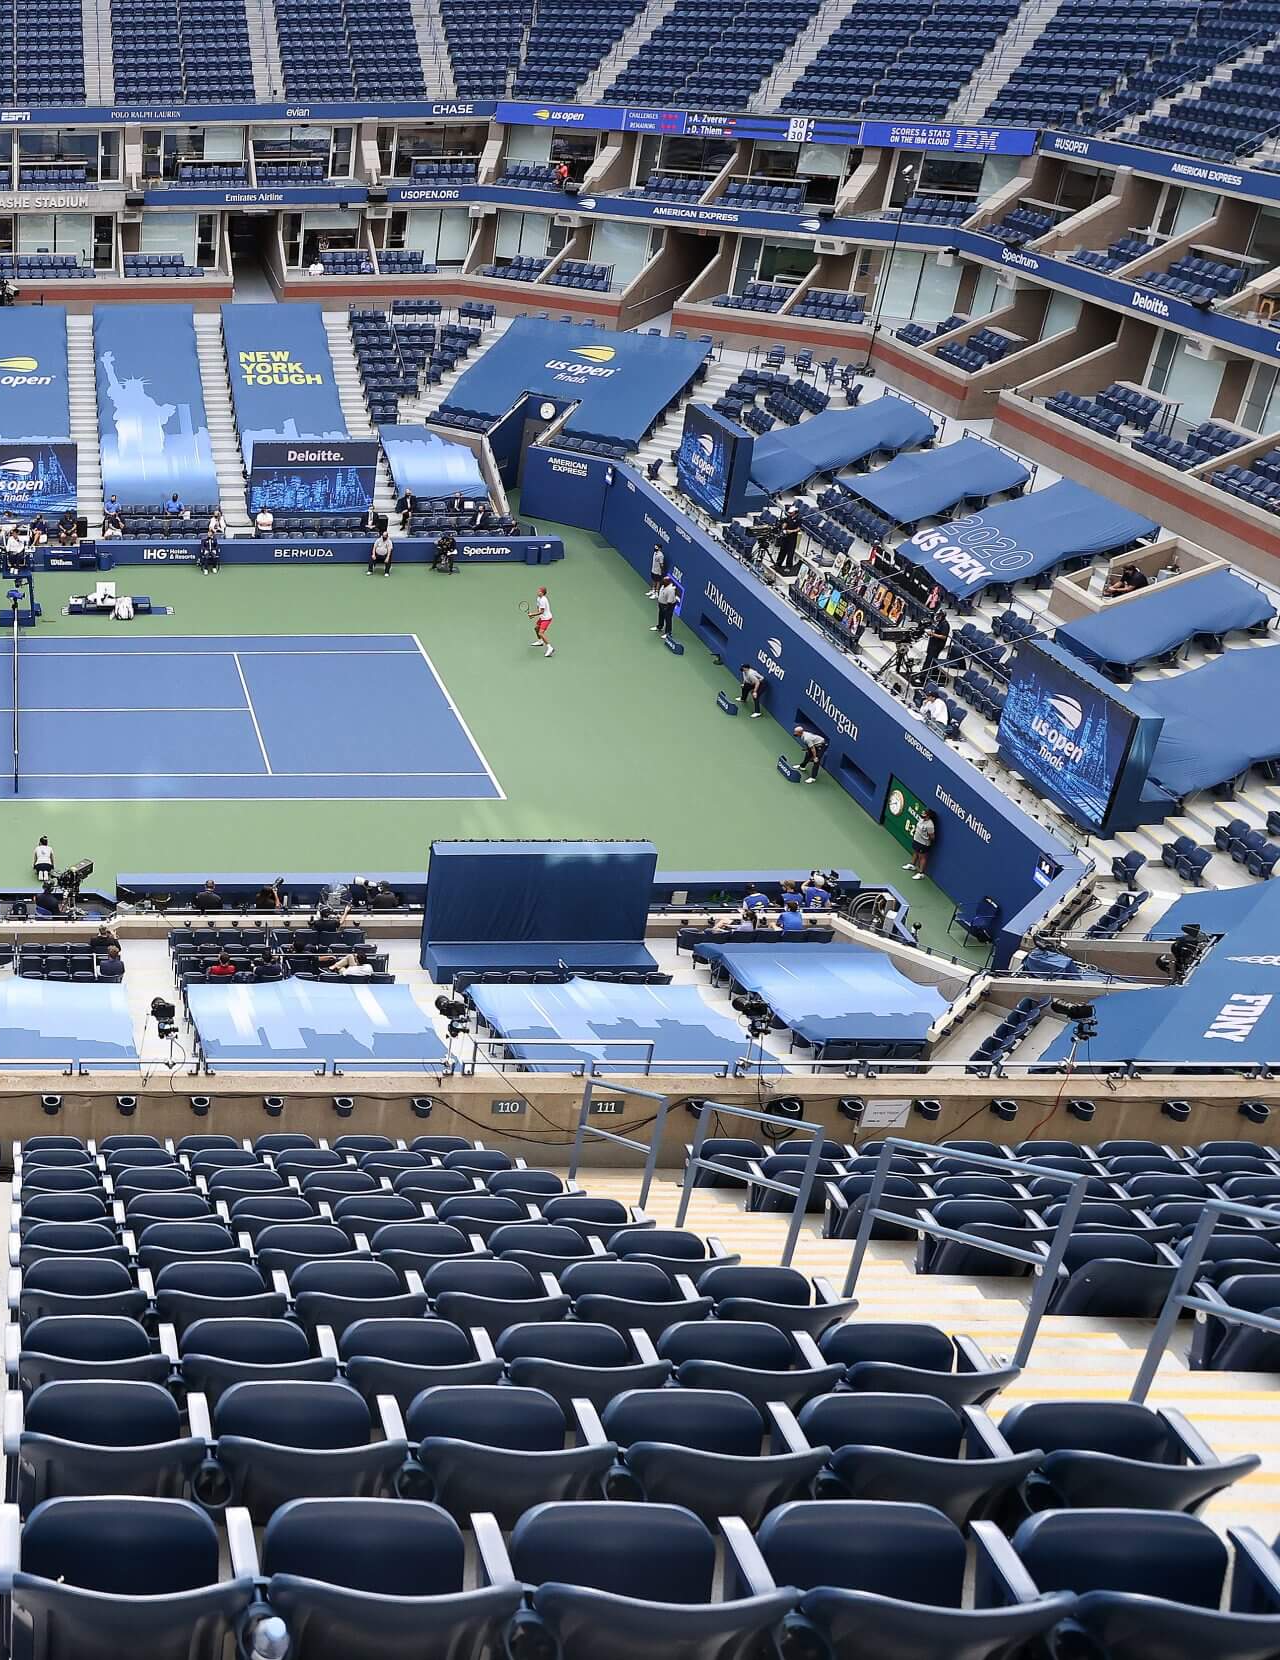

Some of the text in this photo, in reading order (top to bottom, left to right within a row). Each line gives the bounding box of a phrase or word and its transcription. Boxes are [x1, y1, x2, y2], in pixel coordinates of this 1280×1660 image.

[286, 107, 310, 117] evian
[432, 104, 474, 114] CHASE
[1, 112, 31, 121] ESPN
[551, 111, 585, 122] us open
[705, 114, 727, 124] Zverev
[700, 126, 722, 136] Thiem
[792, 120, 816, 130] 30 4
[791, 131, 812, 141] 30 2
[891, 128, 919, 136] SCORES
[928, 129, 951, 138] STATS
[900, 136, 913, 144] THE
[928, 138, 950, 146] CLOUD
[953, 130, 1000, 150] IBM
[1054, 137, 1089, 155] #USOPEN
[1171, 163, 1242, 186] AMERICAN EXPRESS
[225, 192, 284, 202] Emirates Airline
[400, 190, 459, 200] USOPEN.ORG
[0, 198, 31, 210] ASHE
[34, 196, 89, 208] STADIUM
[653, 207, 739, 222] AMERICAN EXPRESS
[1001, 248, 1036, 269] Spectrum
[1132, 292, 1170, 317] Deloitte.
[239, 351, 290, 362] NEW
[240, 362, 304, 374] YORK
[544, 359, 615, 379] us open
[0, 376, 52, 388] open
[242, 374, 323, 385] TOUGH
[553, 372, 589, 385] finals
[287, 450, 344, 462] Deloitte.
[547, 457, 588, 470] AMERICAN
[692, 454, 714, 476] us open
[552, 464, 588, 477] EXPRESS
[10, 480, 44, 494] open
[3, 492, 29, 502] finals
[940, 515, 1034, 571] 2020
[143, 549, 167, 560] IHG
[274, 548, 334, 558] BERMUDA
[463, 546, 508, 557] Spectrum
[911, 528, 994, 585] US OPEN
[704, 580, 744, 630] J.P.Morgan
[757, 649, 785, 681] us open
[805, 679, 858, 742] J.P.Morgan
[1031, 715, 1084, 764] us open
[904, 732, 934, 762] USOPEN.ORG
[1038, 746, 1065, 772] finals
[935, 784, 967, 820] Emirates
[965, 812, 992, 844] Airline
[1203, 993, 1273, 1042] FDNY
[498, 1101, 520, 1113] 110
[596, 1102, 616, 1113] 111
